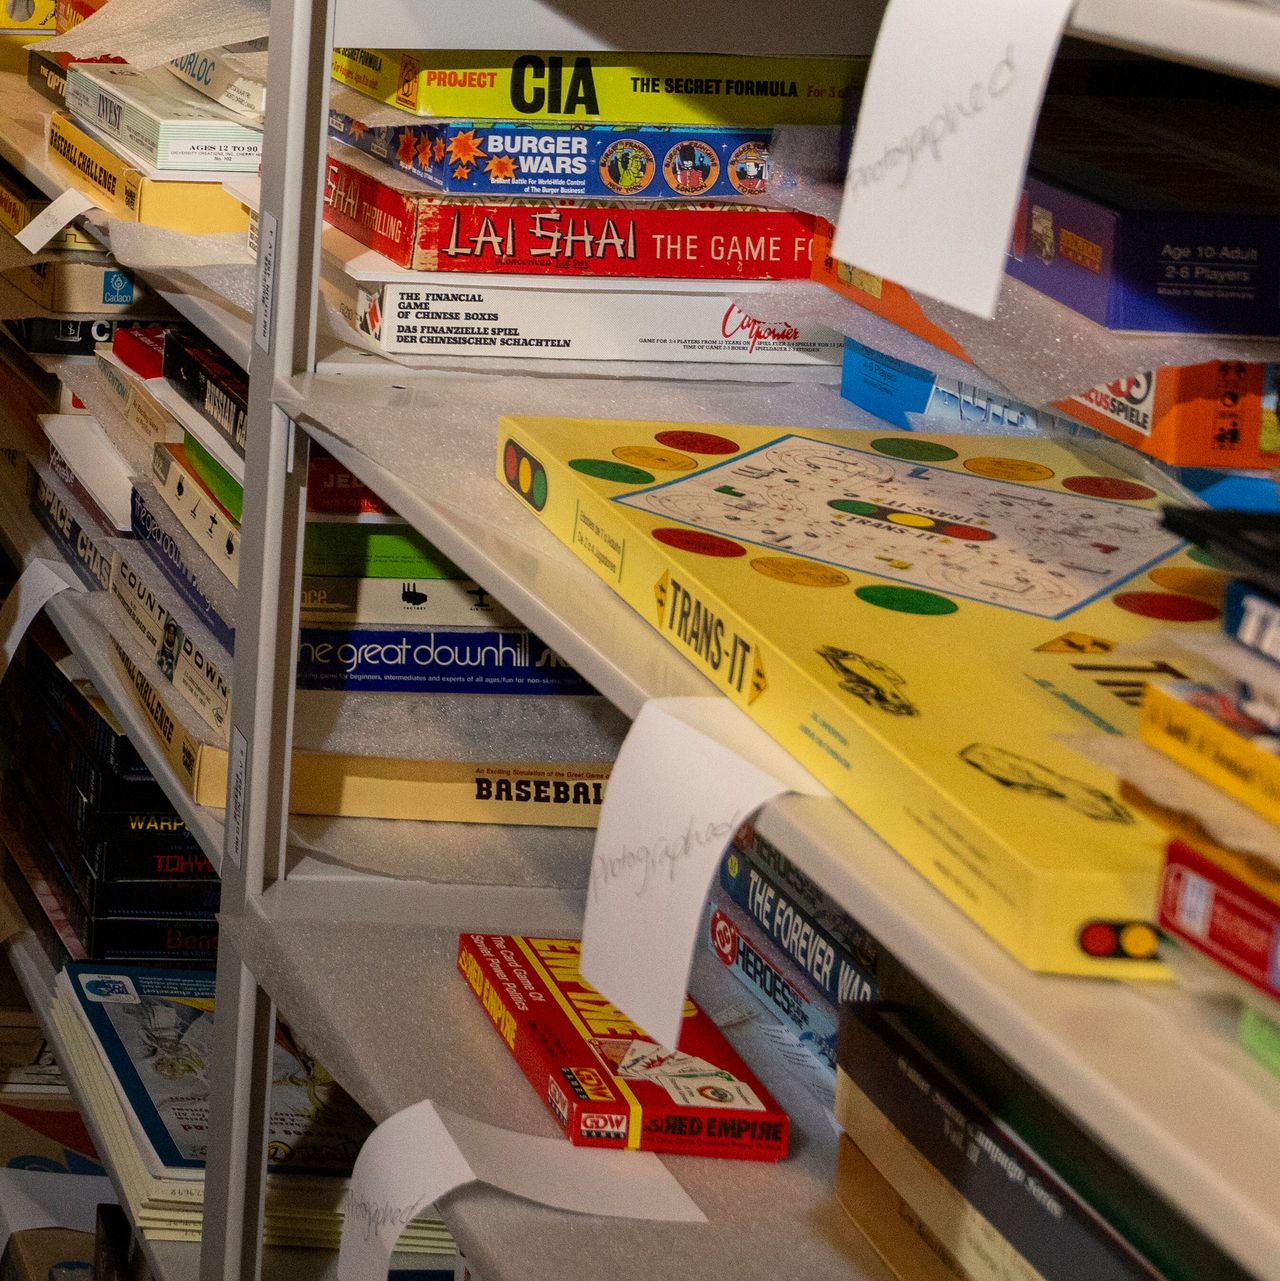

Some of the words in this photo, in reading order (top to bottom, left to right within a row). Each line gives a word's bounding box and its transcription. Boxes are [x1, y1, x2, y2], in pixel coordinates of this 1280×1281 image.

[426, 70, 498, 89] PROJECT
[509, 54, 600, 116] CIA
[630, 76, 663, 94] THE
[664, 77, 732, 95] SECRET
[734, 78, 799, 98] FORMULA
[96, 93, 124, 131] INVEST
[188, 144, 217, 152] AGES
[218, 144, 229, 152] 12
[230, 144, 244, 152] TO
[245, 144, 259, 153] 90
[486, 135, 588, 156] BURGER
[49, 128, 79, 167] BASEBALL
[77, 151, 118, 197] CHALLENGE
[519, 154, 588, 175] WARS
[441, 209, 516, 260] LAI
[529, 208, 636, 260] SHAI
[651, 234, 704, 260] THE
[710, 235, 781, 262] GAME
[1160, 244, 1191, 261] Age
[1196, 245, 1258, 262] 10-Adult
[104, 291, 132, 303] Cadaco
[397, 301, 430, 311] GAME
[399, 292, 421, 302] THE
[425, 293, 484, 303] FINANCIAL
[397, 311, 411, 320] OF
[414, 312, 461, 321] CHINESE
[464, 312, 499, 321] BOXES
[396, 325, 418, 335] DAS
[419, 326, 490, 336] FINANZIELLE
[490, 327, 520, 336] SPIEL
[396, 335, 418, 344] DER
[419, 336, 497, 346] CHINESISCHEN
[499, 338, 572, 348] SCHACHTELN
[120, 561, 167, 622] COUNT
[181, 636, 231, 699] DOWN
[668, 578, 751, 694] TRANS-IT
[337, 636, 412, 673] great
[412, 631, 530, 668] downhill
[349, 672, 383, 682] beginners,
[383, 674, 426, 682] intermediates
[441, 675, 465, 684] experts
[466, 675, 475, 683] of
[475, 675, 484, 683] all
[485, 768, 511, 777] Exciting
[748, 870, 775, 922] THE
[773, 899, 838, 994] FOREVER
[735, 941, 792, 1018] HEROES
[581, 1113, 627, 1131] GDW
[662, 1113, 703, 1136] RED
[705, 1115, 784, 1142] EMPIRE
[581, 1130, 627, 1139] GAMES
